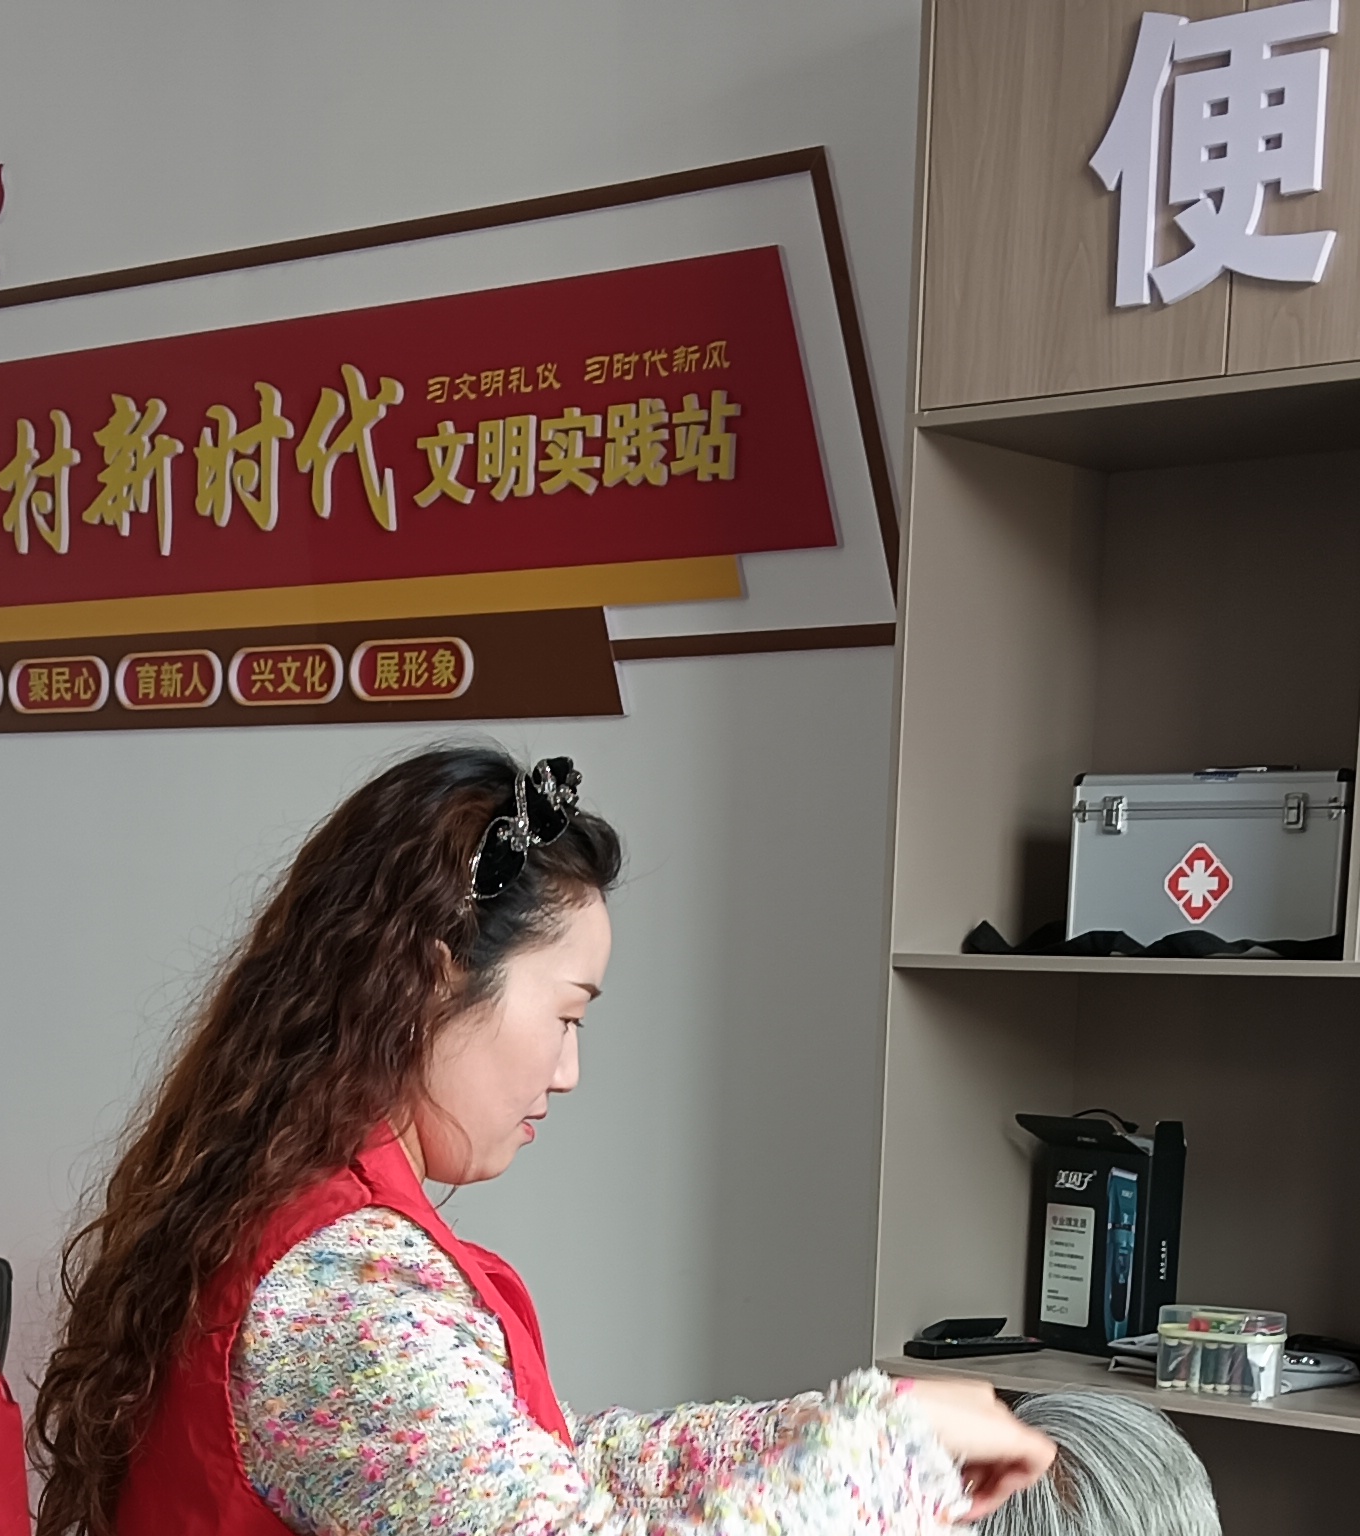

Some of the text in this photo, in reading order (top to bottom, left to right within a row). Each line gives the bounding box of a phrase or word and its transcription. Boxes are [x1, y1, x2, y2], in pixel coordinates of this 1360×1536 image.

[426, 340, 731, 404] 习文明礼仪 习时代新风
[413, 390, 741, 507] 文明实践站
[27, 666, 95, 702] 聚民心
[134, 661, 208, 699] 育新人
[249, 654, 327, 695] 兴文化
[372, 649, 458, 690] 展形象
